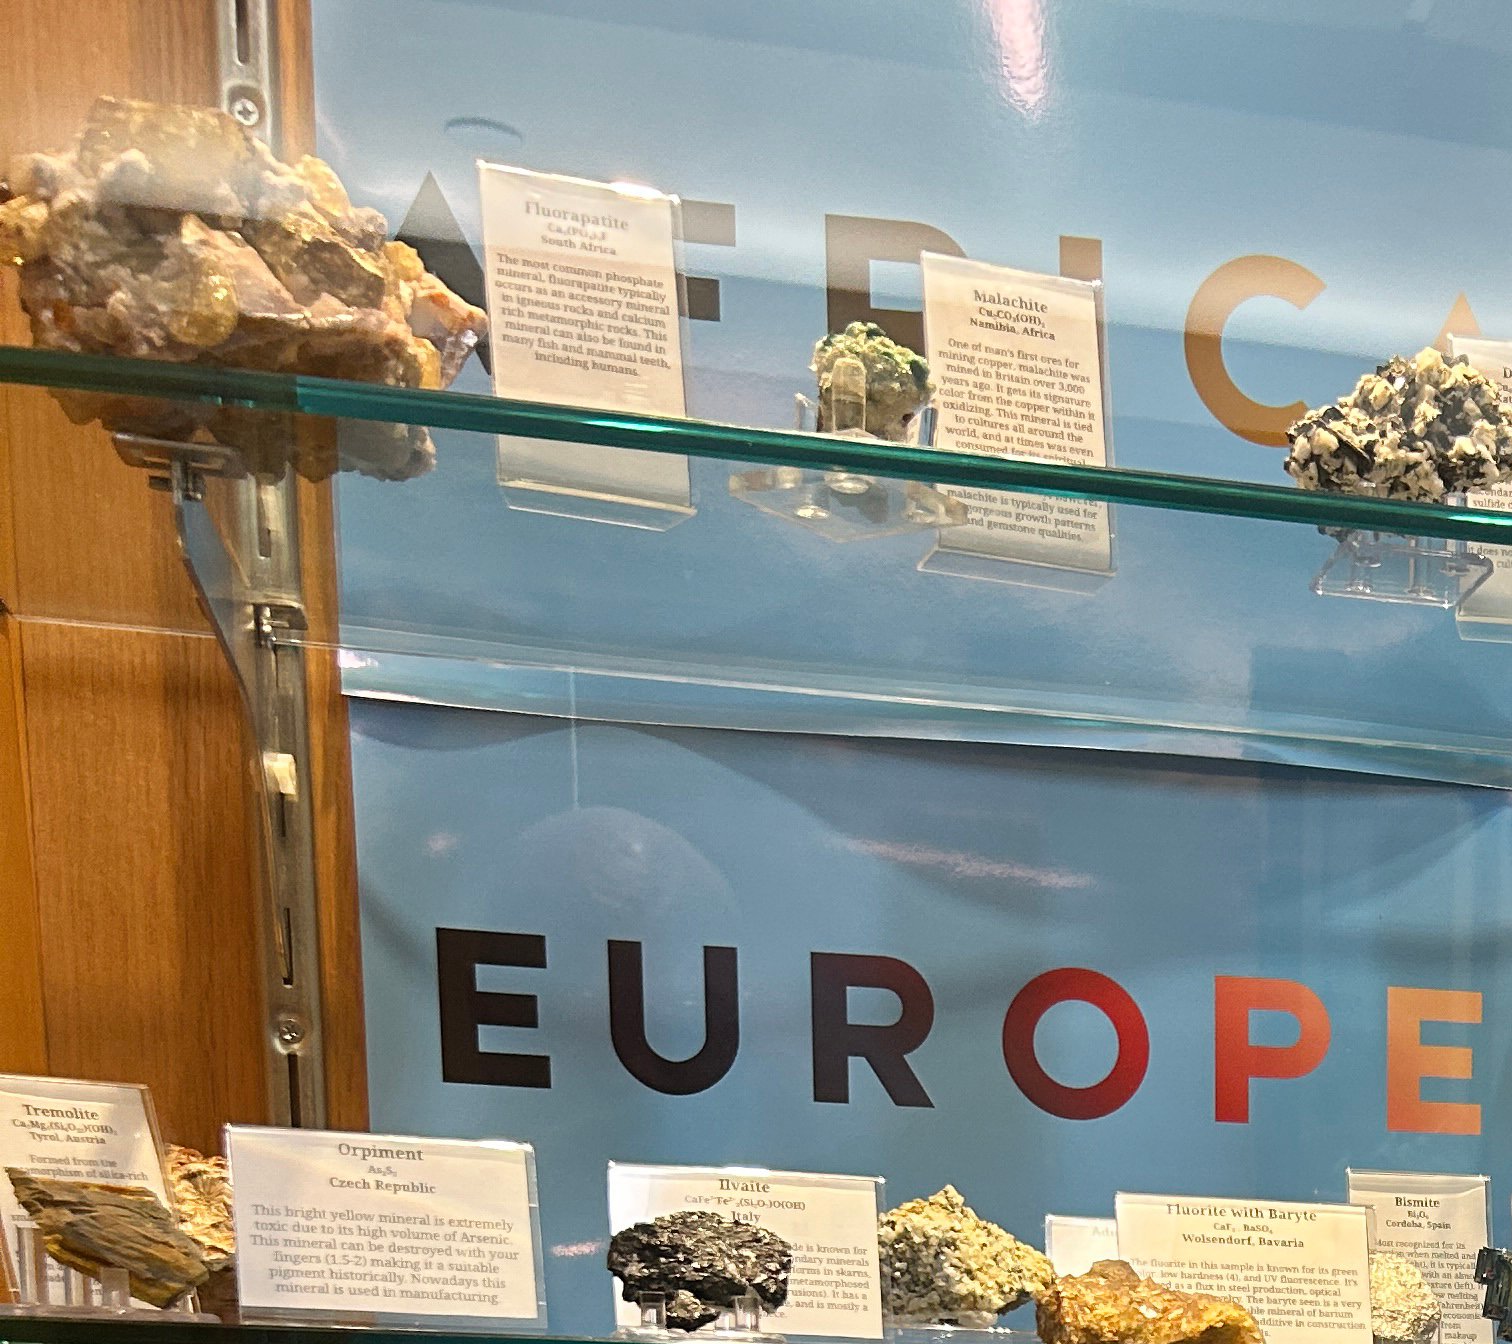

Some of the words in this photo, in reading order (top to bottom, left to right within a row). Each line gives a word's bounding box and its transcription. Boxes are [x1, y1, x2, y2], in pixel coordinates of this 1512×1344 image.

[523, 201, 629, 234] Fluorapatite
[579, 241, 617, 255] Africa
[972, 289, 1048, 313] Malachite
[1022, 326, 1056, 340] Africa
[436, 927, 1483, 1135] EUROPE
[22, 1105, 98, 1120] Tremolite
[65, 1133, 106, 1144] Austria
[337, 1145, 423, 1163] Orpiment
[329, 1176, 370, 1190] Czech
[374, 1179, 435, 1196] Republic
[720, 1180, 769, 1193] Ilvaite
[1395, 1196, 1439, 1208] Bismite
[250, 1204, 281, 1217] This
[284, 1206, 326, 1223] bright
[329, 1208, 374, 1226] yellow
[377, 1211, 431, 1226] mineral
[434, 1215, 445, 1227] is
[447, 1215, 513, 1234] extremely
[730, 1211, 760, 1225] Italy
[1166, 1204, 1226, 1218] Fluorite
[1230, 1206, 1264, 1219] with
[1268, 1208, 1316, 1224] Baryte
[1258, 1236, 1303, 1247] Bavaria
